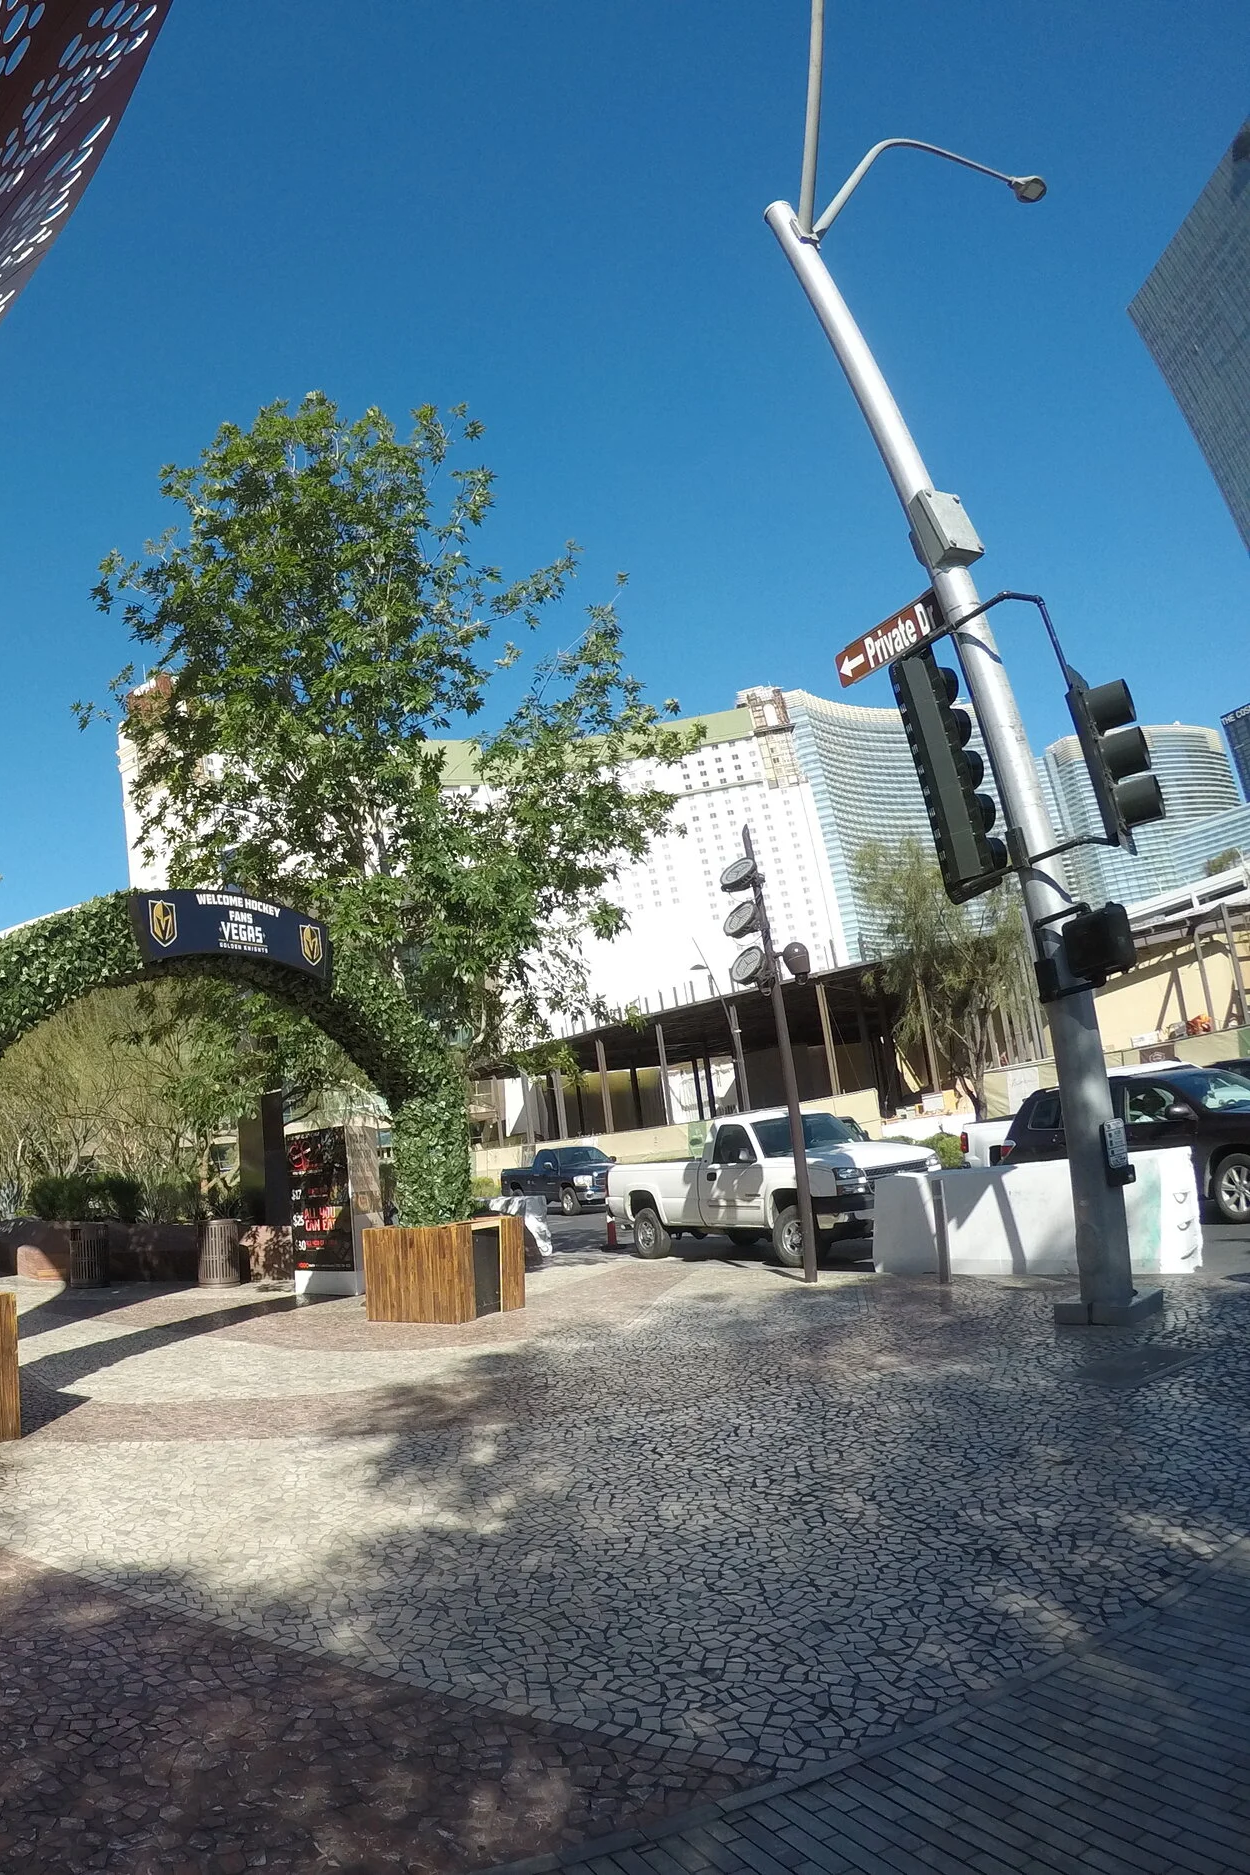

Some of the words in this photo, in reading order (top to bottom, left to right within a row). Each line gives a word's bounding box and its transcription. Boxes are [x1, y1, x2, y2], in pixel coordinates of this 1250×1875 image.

[864, 616, 917, 668] Private
[1222, 713, 1236, 725] THE
[196, 894, 243, 907] WELCOME
[244, 898, 281, 917] HOCKEY
[229, 910, 253, 923] FANS
[220, 921, 263, 943] VEGAS
[219, 942, 242, 950] GOLDEN
[243, 945, 268, 953] KNIGHTS
[304, 1207, 318, 1219] ALL
[320, 1206, 336, 1219] YOU
[293, 1213, 304, 1227] $25
[305, 1219, 320, 1231] CAN
[295, 1240, 306, 1251] $30
